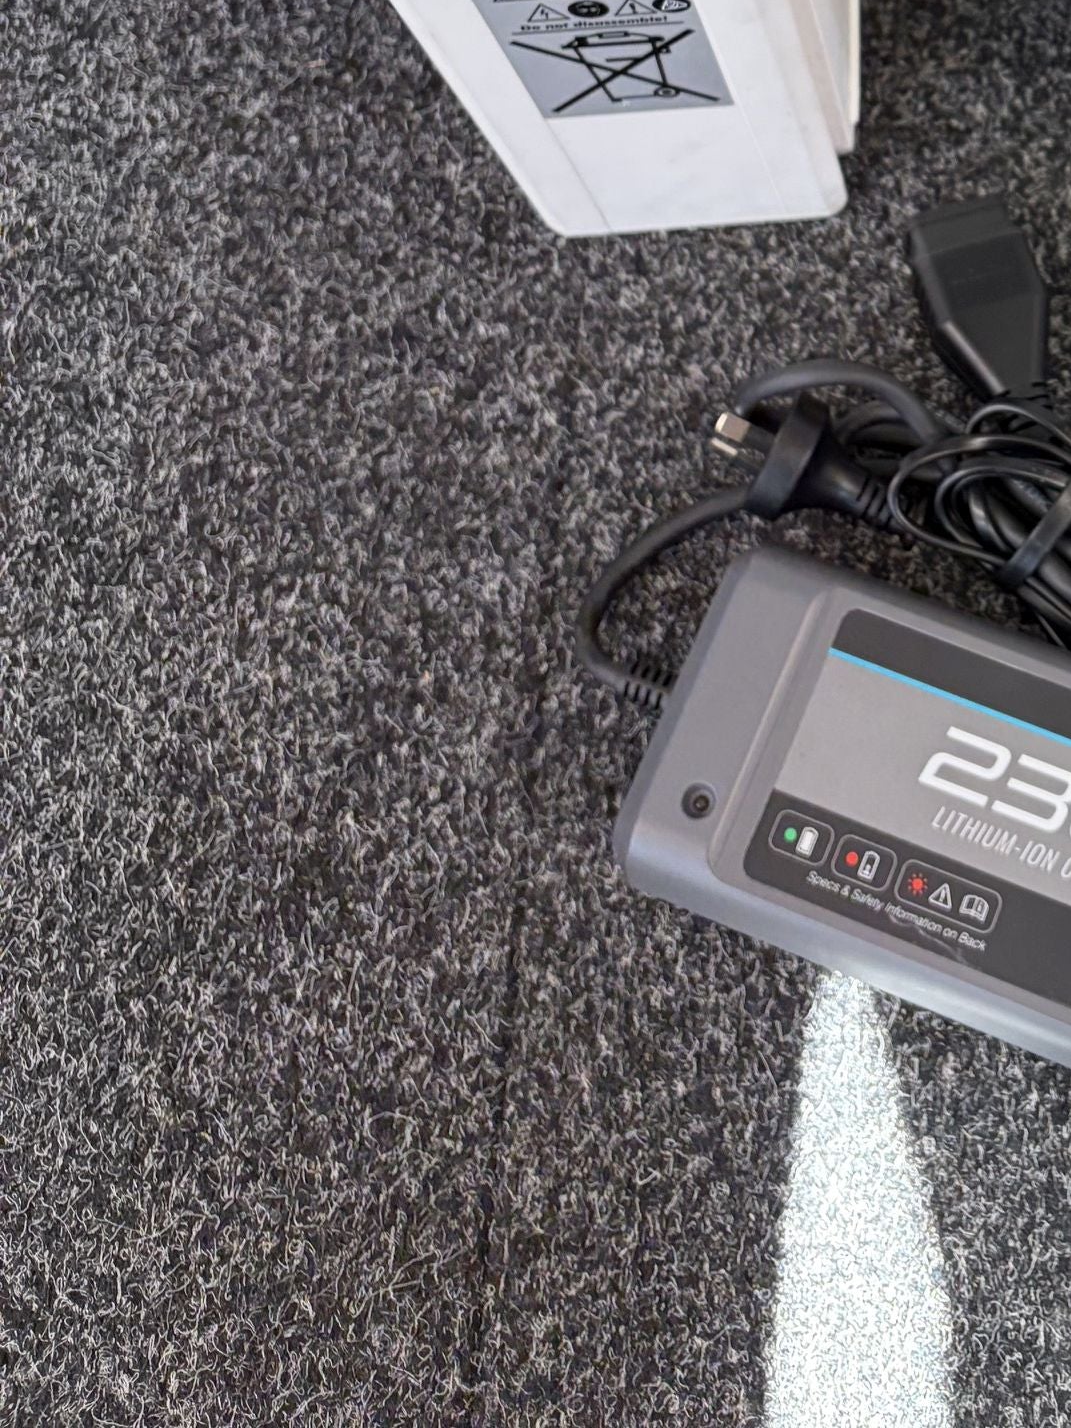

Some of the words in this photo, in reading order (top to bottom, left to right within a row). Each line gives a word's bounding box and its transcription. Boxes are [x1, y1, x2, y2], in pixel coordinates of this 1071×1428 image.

[520, 23, 542, 32] Do
[544, 20, 571, 31] not
[930, 805, 1060, 871] LITHIUM-ION
[805, 870, 841, 894] Specs
[840, 885, 850, 897] &
[850, 888, 884, 912] Safety
[885, 901, 943, 936] Information
[942, 927, 958, 940] on
[957, 931, 988, 952] Back
